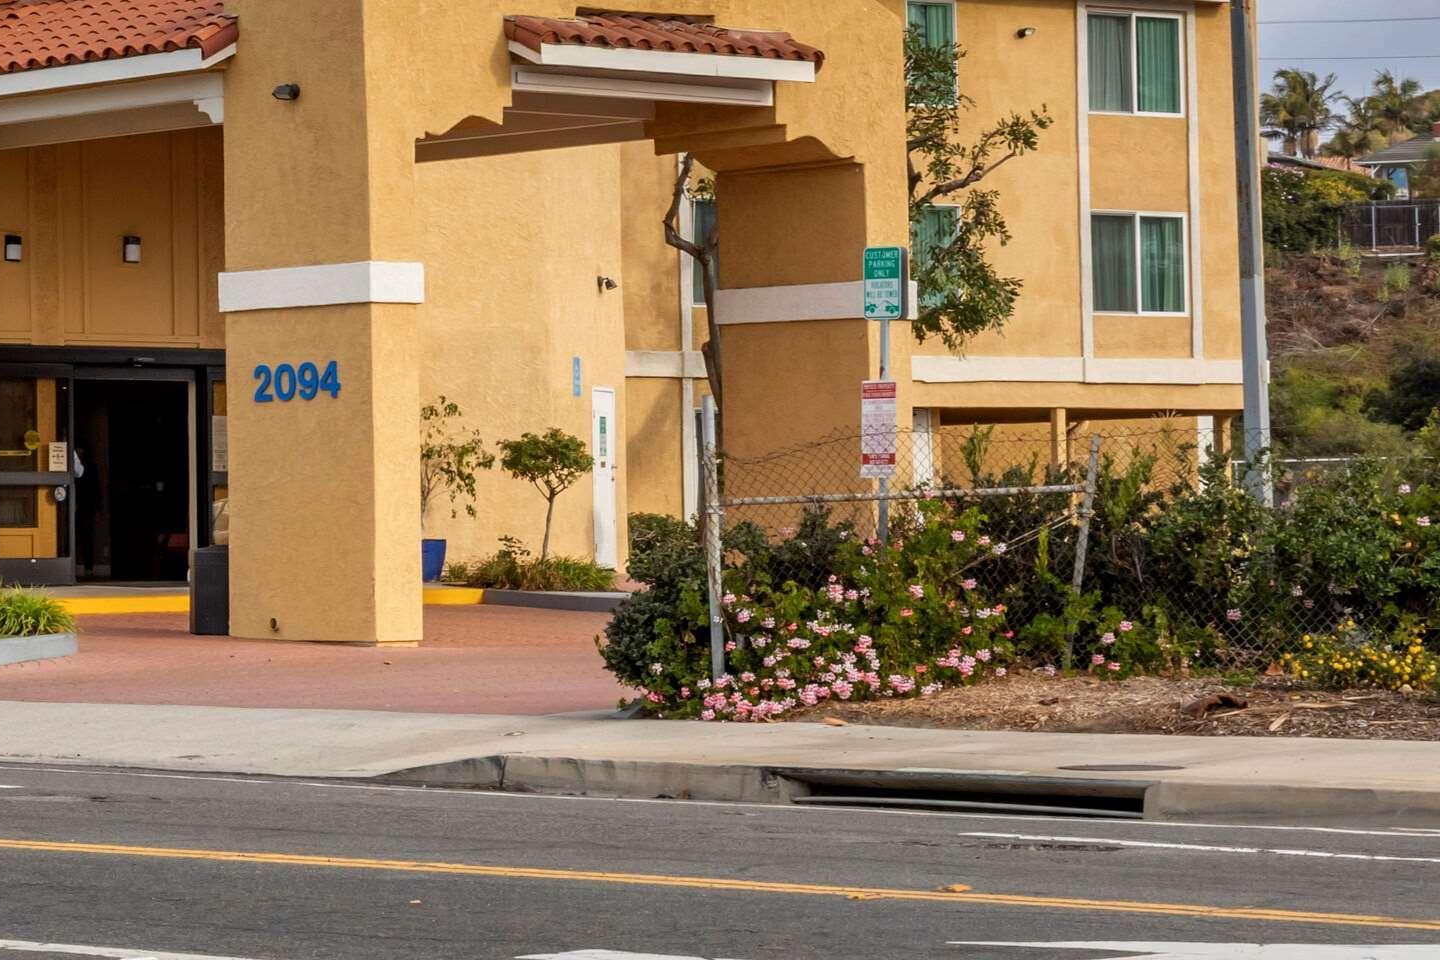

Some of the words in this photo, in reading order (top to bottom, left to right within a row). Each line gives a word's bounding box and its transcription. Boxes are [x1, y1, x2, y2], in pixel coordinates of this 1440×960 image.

[865, 250, 898, 260] CUSTOMER
[868, 259, 896, 269] PARKING
[254, 360, 342, 403] 2094
